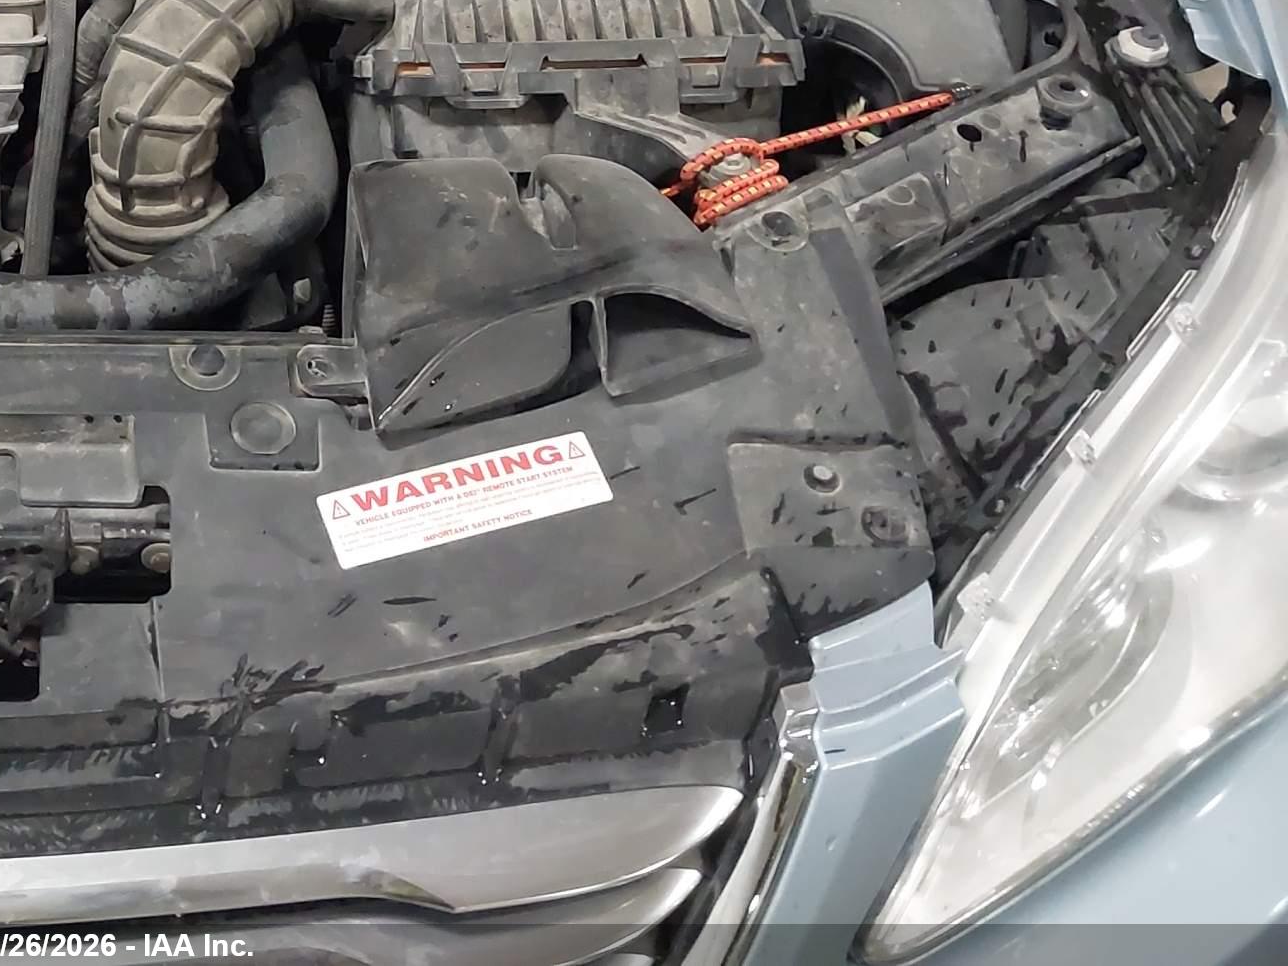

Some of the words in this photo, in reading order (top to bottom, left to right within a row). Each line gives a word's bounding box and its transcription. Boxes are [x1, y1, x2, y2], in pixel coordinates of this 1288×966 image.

[351, 445, 564, 512] WARNING
[355, 511, 390, 527] VEHICLE
[391, 500, 432, 517] EQUIPPED
[432, 494, 455, 506] WITH
[482, 479, 516, 494] REMOTE
[516, 472, 541, 485] START
[542, 465, 574, 478] SYSTEM
[423, 525, 470, 542] IMPORTANT
[471, 516, 502, 530] SAFETY
[502, 508, 534, 521] NOTICE
